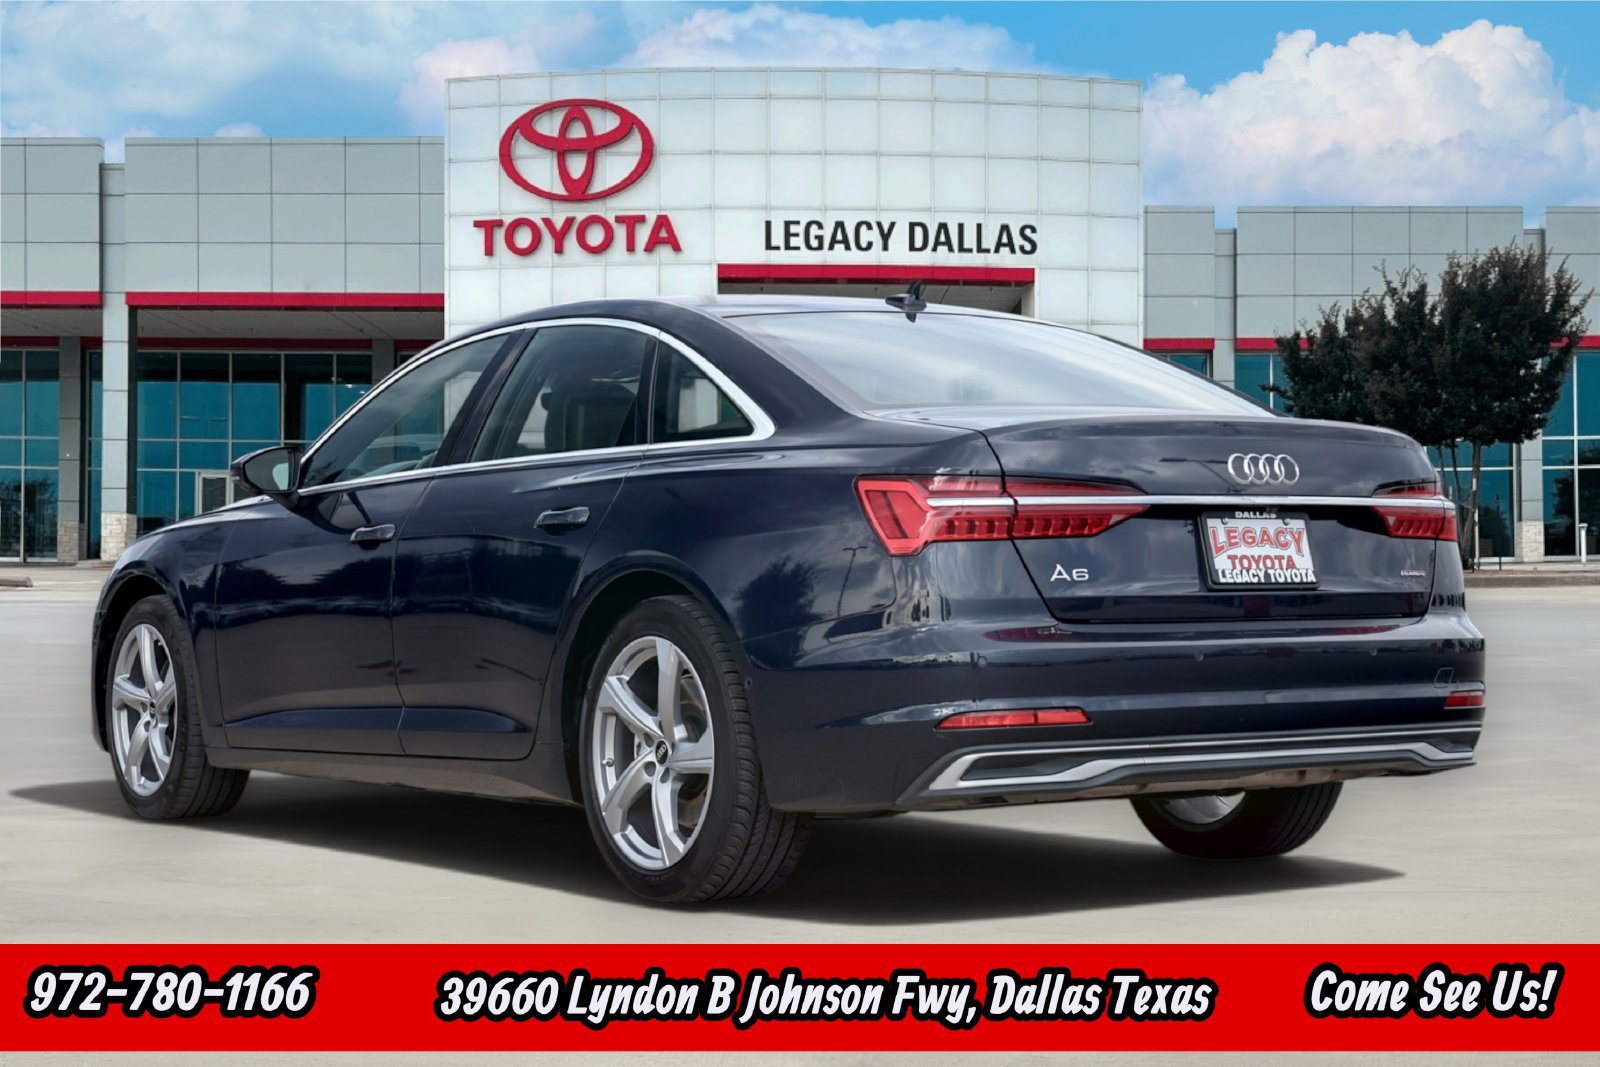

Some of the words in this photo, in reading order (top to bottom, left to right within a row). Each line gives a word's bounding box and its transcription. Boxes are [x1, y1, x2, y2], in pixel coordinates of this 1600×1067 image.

[473, 214, 682, 257] TOYOTA
[765, 220, 896, 252] LEGACY
[908, 221, 1038, 255] DALLAS
[1234, 511, 1277, 519] DALLAS
[1209, 526, 1305, 558] LEGACY
[1049, 563, 1090, 582] A6
[1227, 555, 1297, 571] TOYOTA
[1217, 569, 1266, 583] LEGACY
[1267, 569, 1316, 583] TOYOTA
